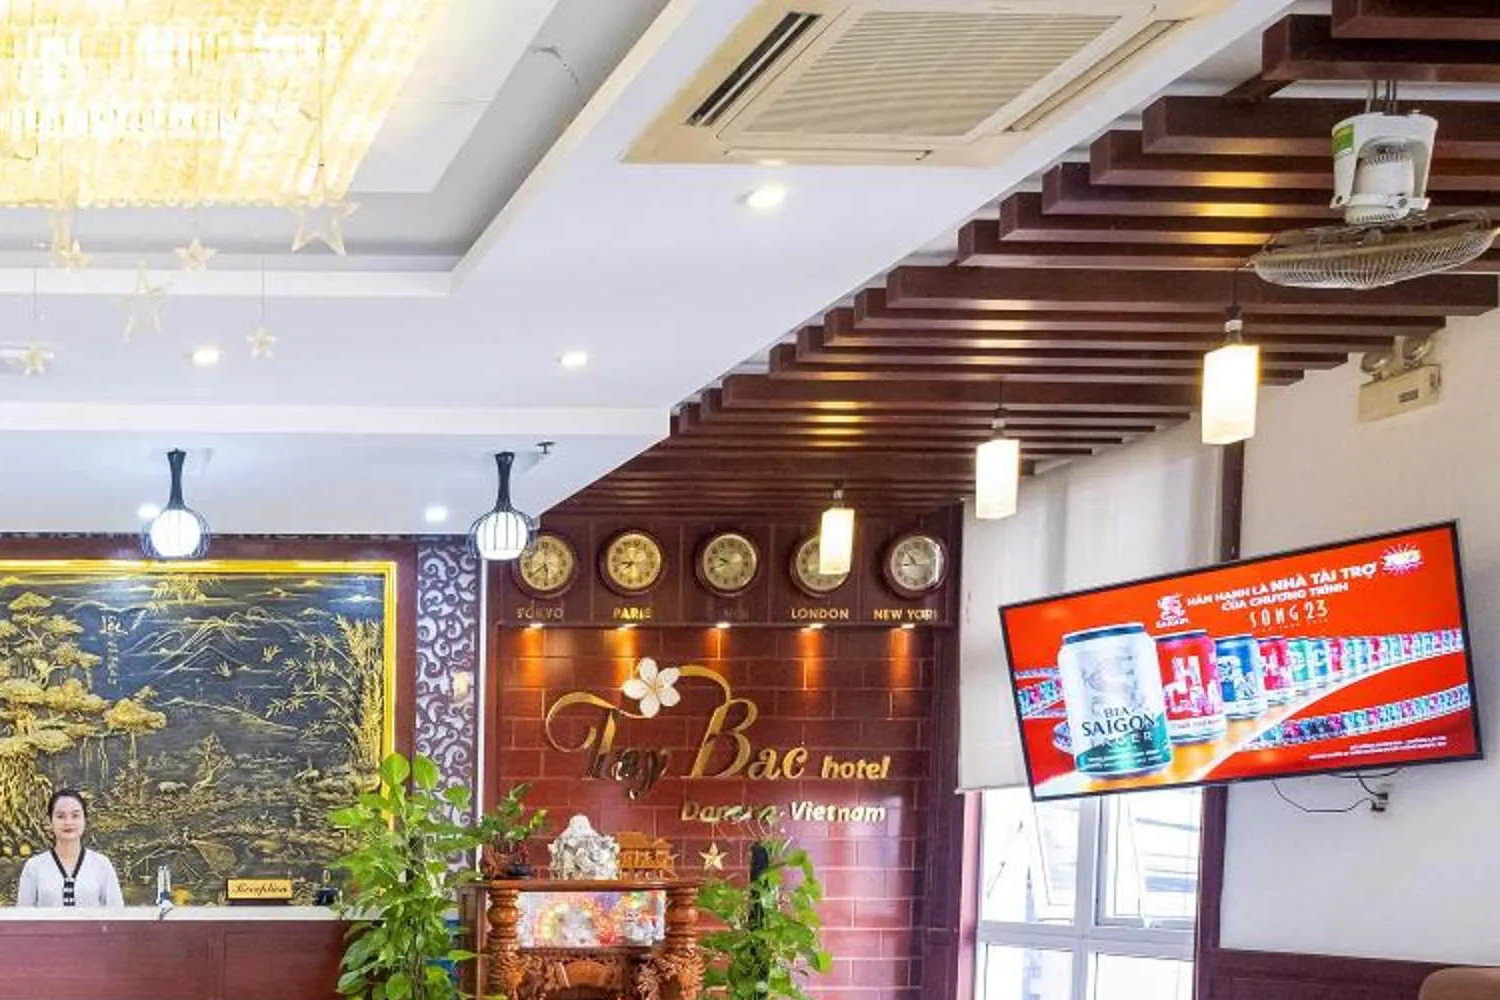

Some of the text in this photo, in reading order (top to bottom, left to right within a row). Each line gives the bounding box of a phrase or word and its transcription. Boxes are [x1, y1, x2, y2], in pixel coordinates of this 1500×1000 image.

[1270, 573, 1309, 593] NHÀ
[1339, 562, 1378, 580] TRỢ
[612, 607, 653, 620] PARIS
[790, 607, 850, 620] LONDON
[873, 607, 902, 620] NEW
[1104, 705, 1130, 718] BIA
[1081, 713, 1155, 737] SAIGON
[820, 754, 892, 780] hotel
[789, 800, 887, 823] Vietnam
